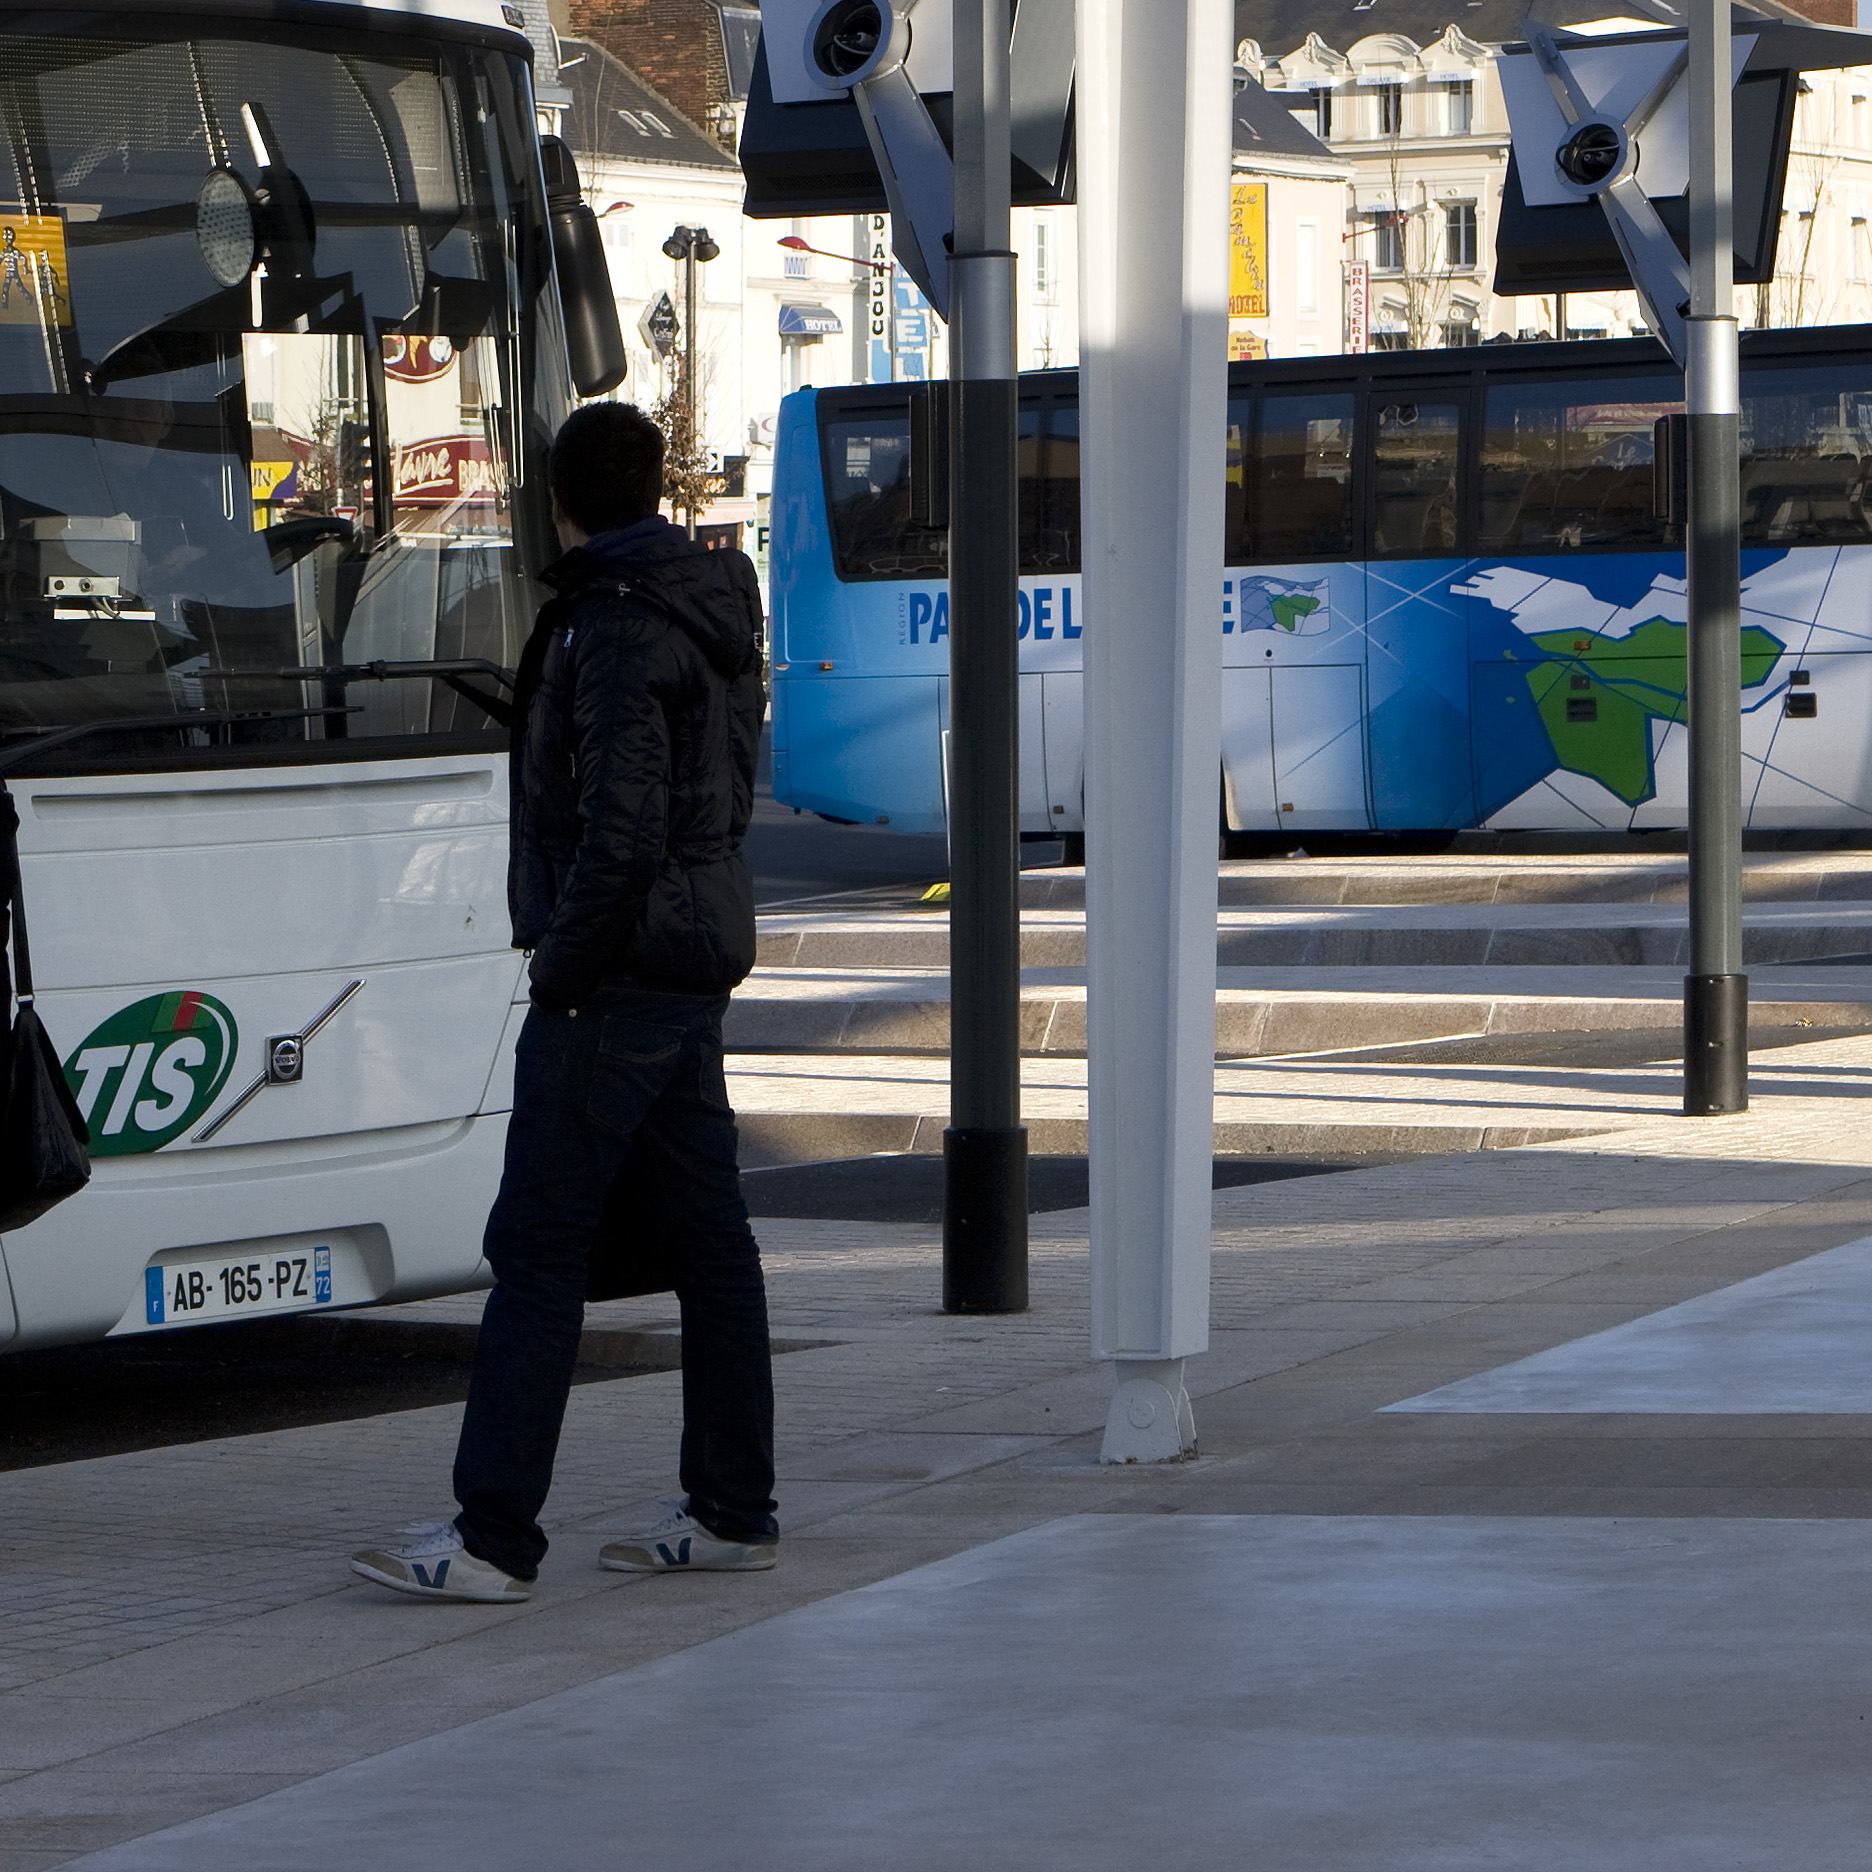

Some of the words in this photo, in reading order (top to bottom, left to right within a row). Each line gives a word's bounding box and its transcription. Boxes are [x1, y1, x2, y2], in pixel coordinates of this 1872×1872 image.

[872, 215, 886, 335] D'ANJOU
[804, 319, 842, 332] HOTEL
[895, 278, 925, 381] TEL
[909, 592, 949, 645] PA
[1062, 587, 1083, 640] L
[75, 1036, 206, 1135] TIS
[153, 1300, 159, 1312] F
[316, 1277, 330, 1295] 72
